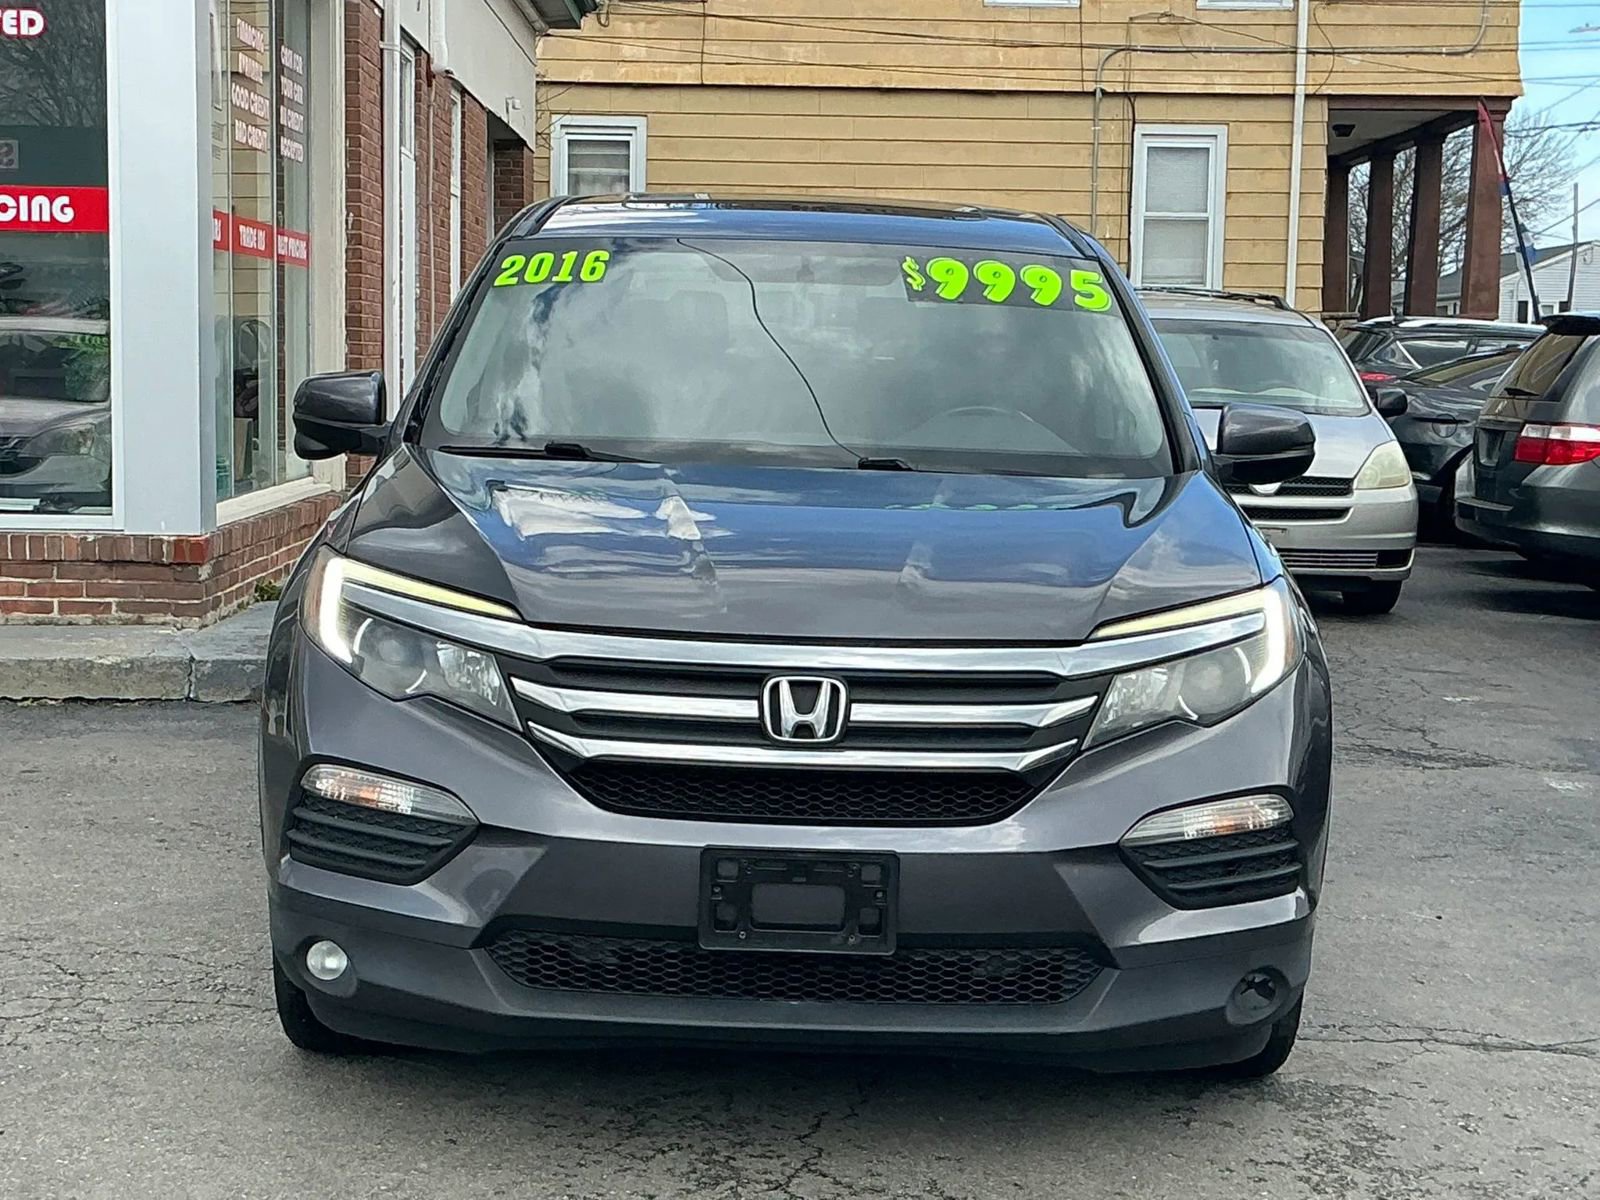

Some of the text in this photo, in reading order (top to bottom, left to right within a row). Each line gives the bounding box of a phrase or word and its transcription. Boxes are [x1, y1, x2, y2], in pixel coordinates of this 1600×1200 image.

[231, 82, 270, 121] GOOD CREDIT
[247, 124, 268, 153] CREDIT
[287, 108, 304, 134] CREDIT
[493, 250, 610, 287] 2016
[902, 255, 1113, 313] $9995
